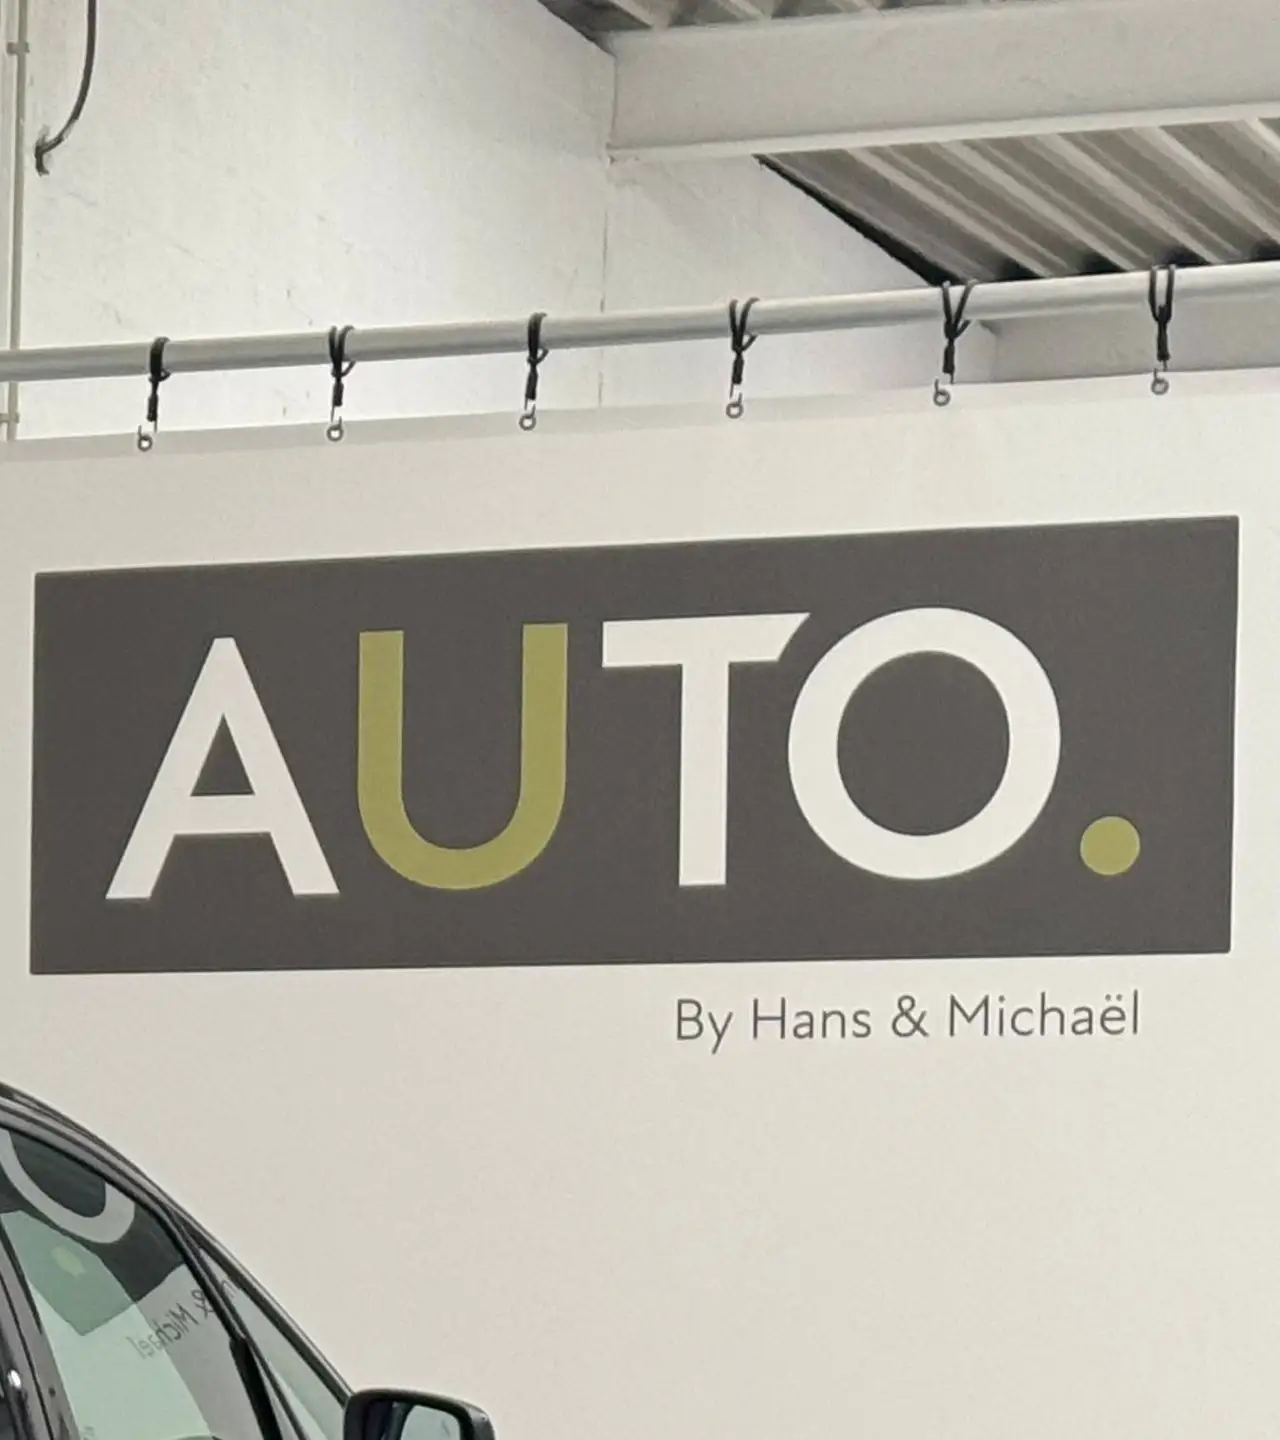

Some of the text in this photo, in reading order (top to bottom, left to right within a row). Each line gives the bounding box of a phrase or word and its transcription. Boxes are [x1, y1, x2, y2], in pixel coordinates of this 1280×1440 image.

[105, 607, 1141, 900] AUTO.
[675, 989, 1140, 1055] By Hans & Michaël
